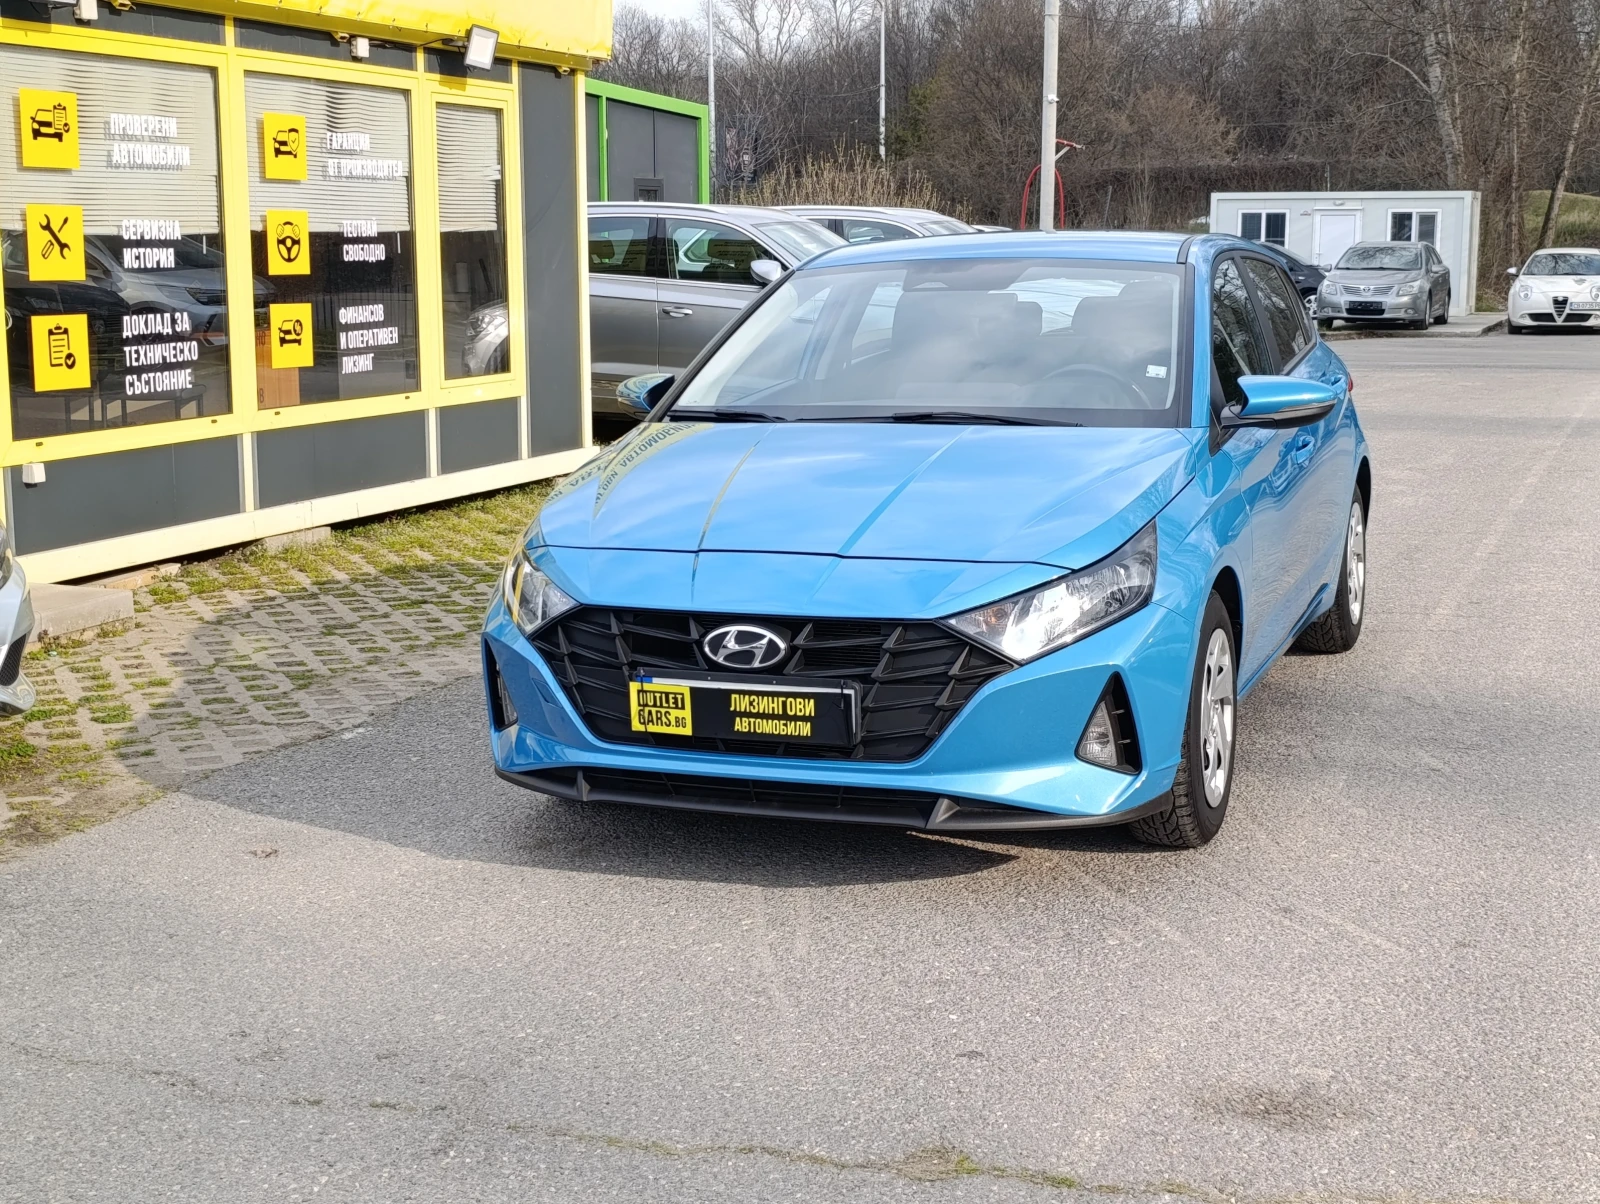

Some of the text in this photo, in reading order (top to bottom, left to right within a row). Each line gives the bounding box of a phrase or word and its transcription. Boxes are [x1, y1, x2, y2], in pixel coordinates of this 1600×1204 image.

[110, 113, 178, 137] ПРОВЕРЕНИ
[112, 143, 191, 166] АВТОМОБИЛИ
[328, 158, 403, 178] ОТ ПРОИЗВОДИТЕЛ
[122, 219, 182, 240] СЕРВИЗНА
[342, 217, 378, 237] ТЕСТВАЙ
[123, 247, 176, 269] ИСТОРИЯ
[343, 243, 386, 263] СВОБОДНО
[122, 311, 190, 339] ДОКЛАД ЗА
[338, 303, 385, 325] ФИНАНСОВ
[340, 326, 399, 350] И ОПЕРАТИВЕН
[123, 340, 199, 367] ТЕХНИЧЕСКО
[341, 353, 375, 375] ЛИЗИНГ
[125, 368, 193, 396] СЪСТОЯНИЕ
[638, 691, 684, 709] OUTLET
[729, 693, 815, 717] ЛИЗИНГОВИ
[637, 708, 687, 729] CARS.BG
[734, 717, 812, 737] АВТОМОБИЛИ
